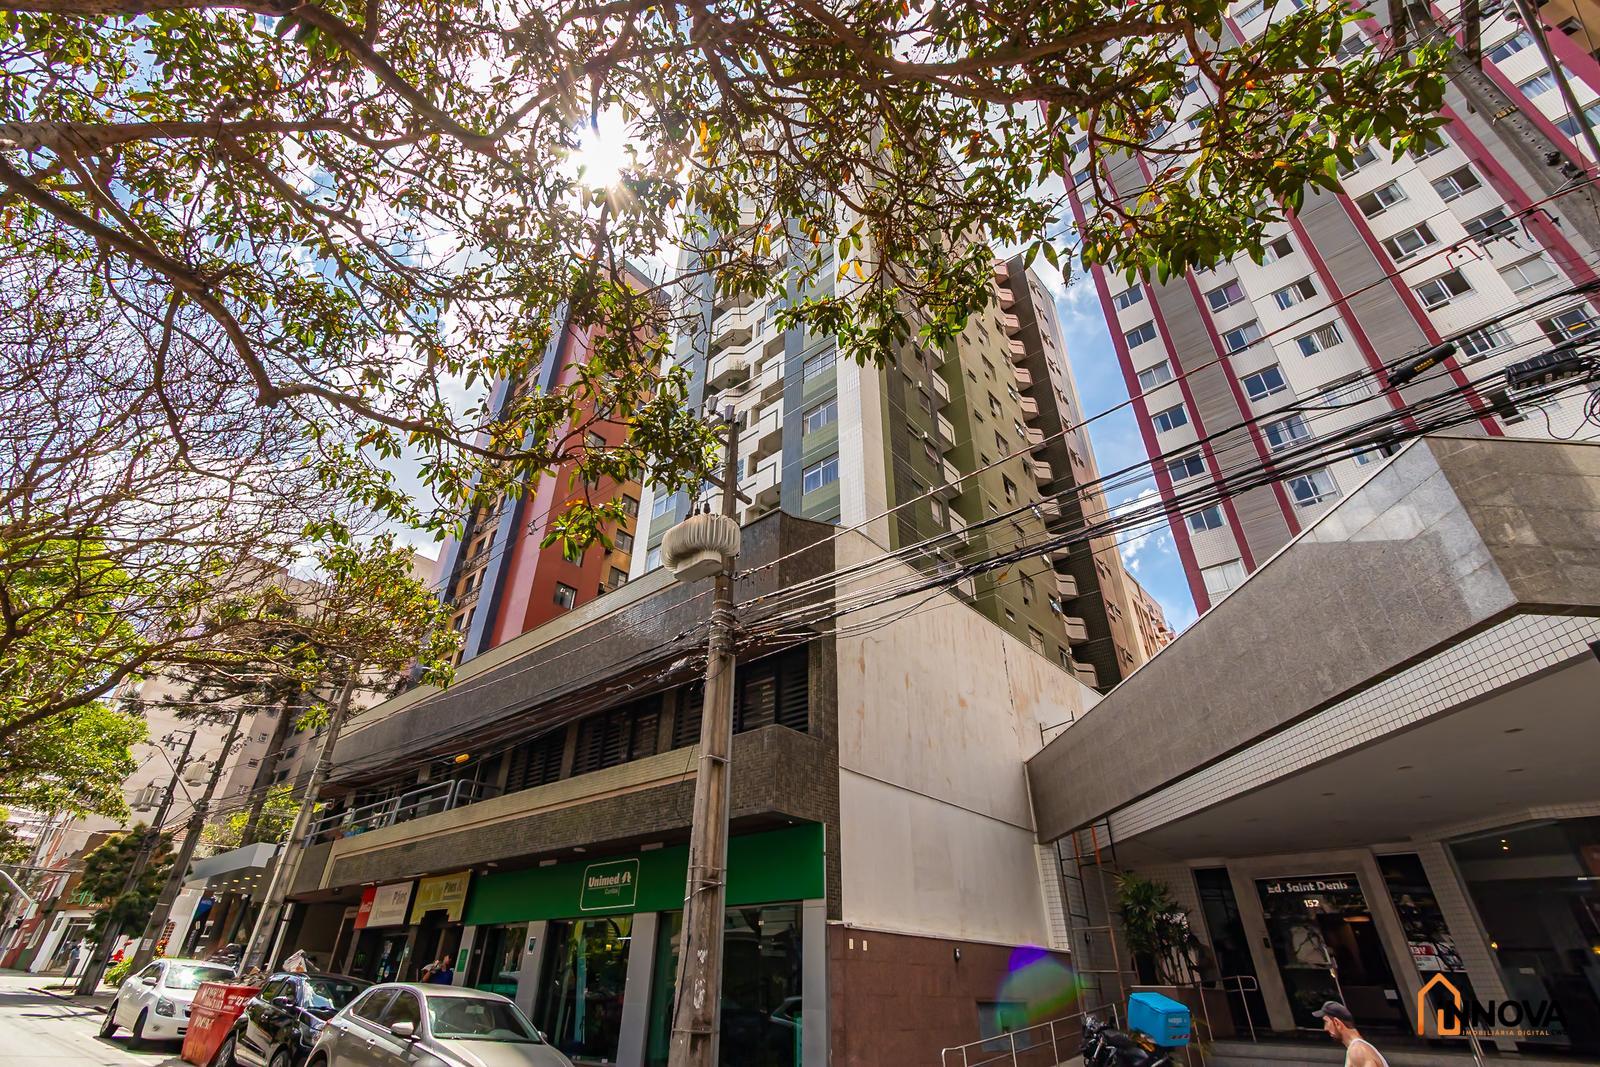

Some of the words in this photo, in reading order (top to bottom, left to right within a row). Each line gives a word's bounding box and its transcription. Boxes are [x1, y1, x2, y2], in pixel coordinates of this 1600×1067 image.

[588, 873, 620, 888] Unimed
[1286, 882, 1315, 893] Saint
[1316, 880, 1348, 891] Denis
[1303, 899, 1320, 908] 152
